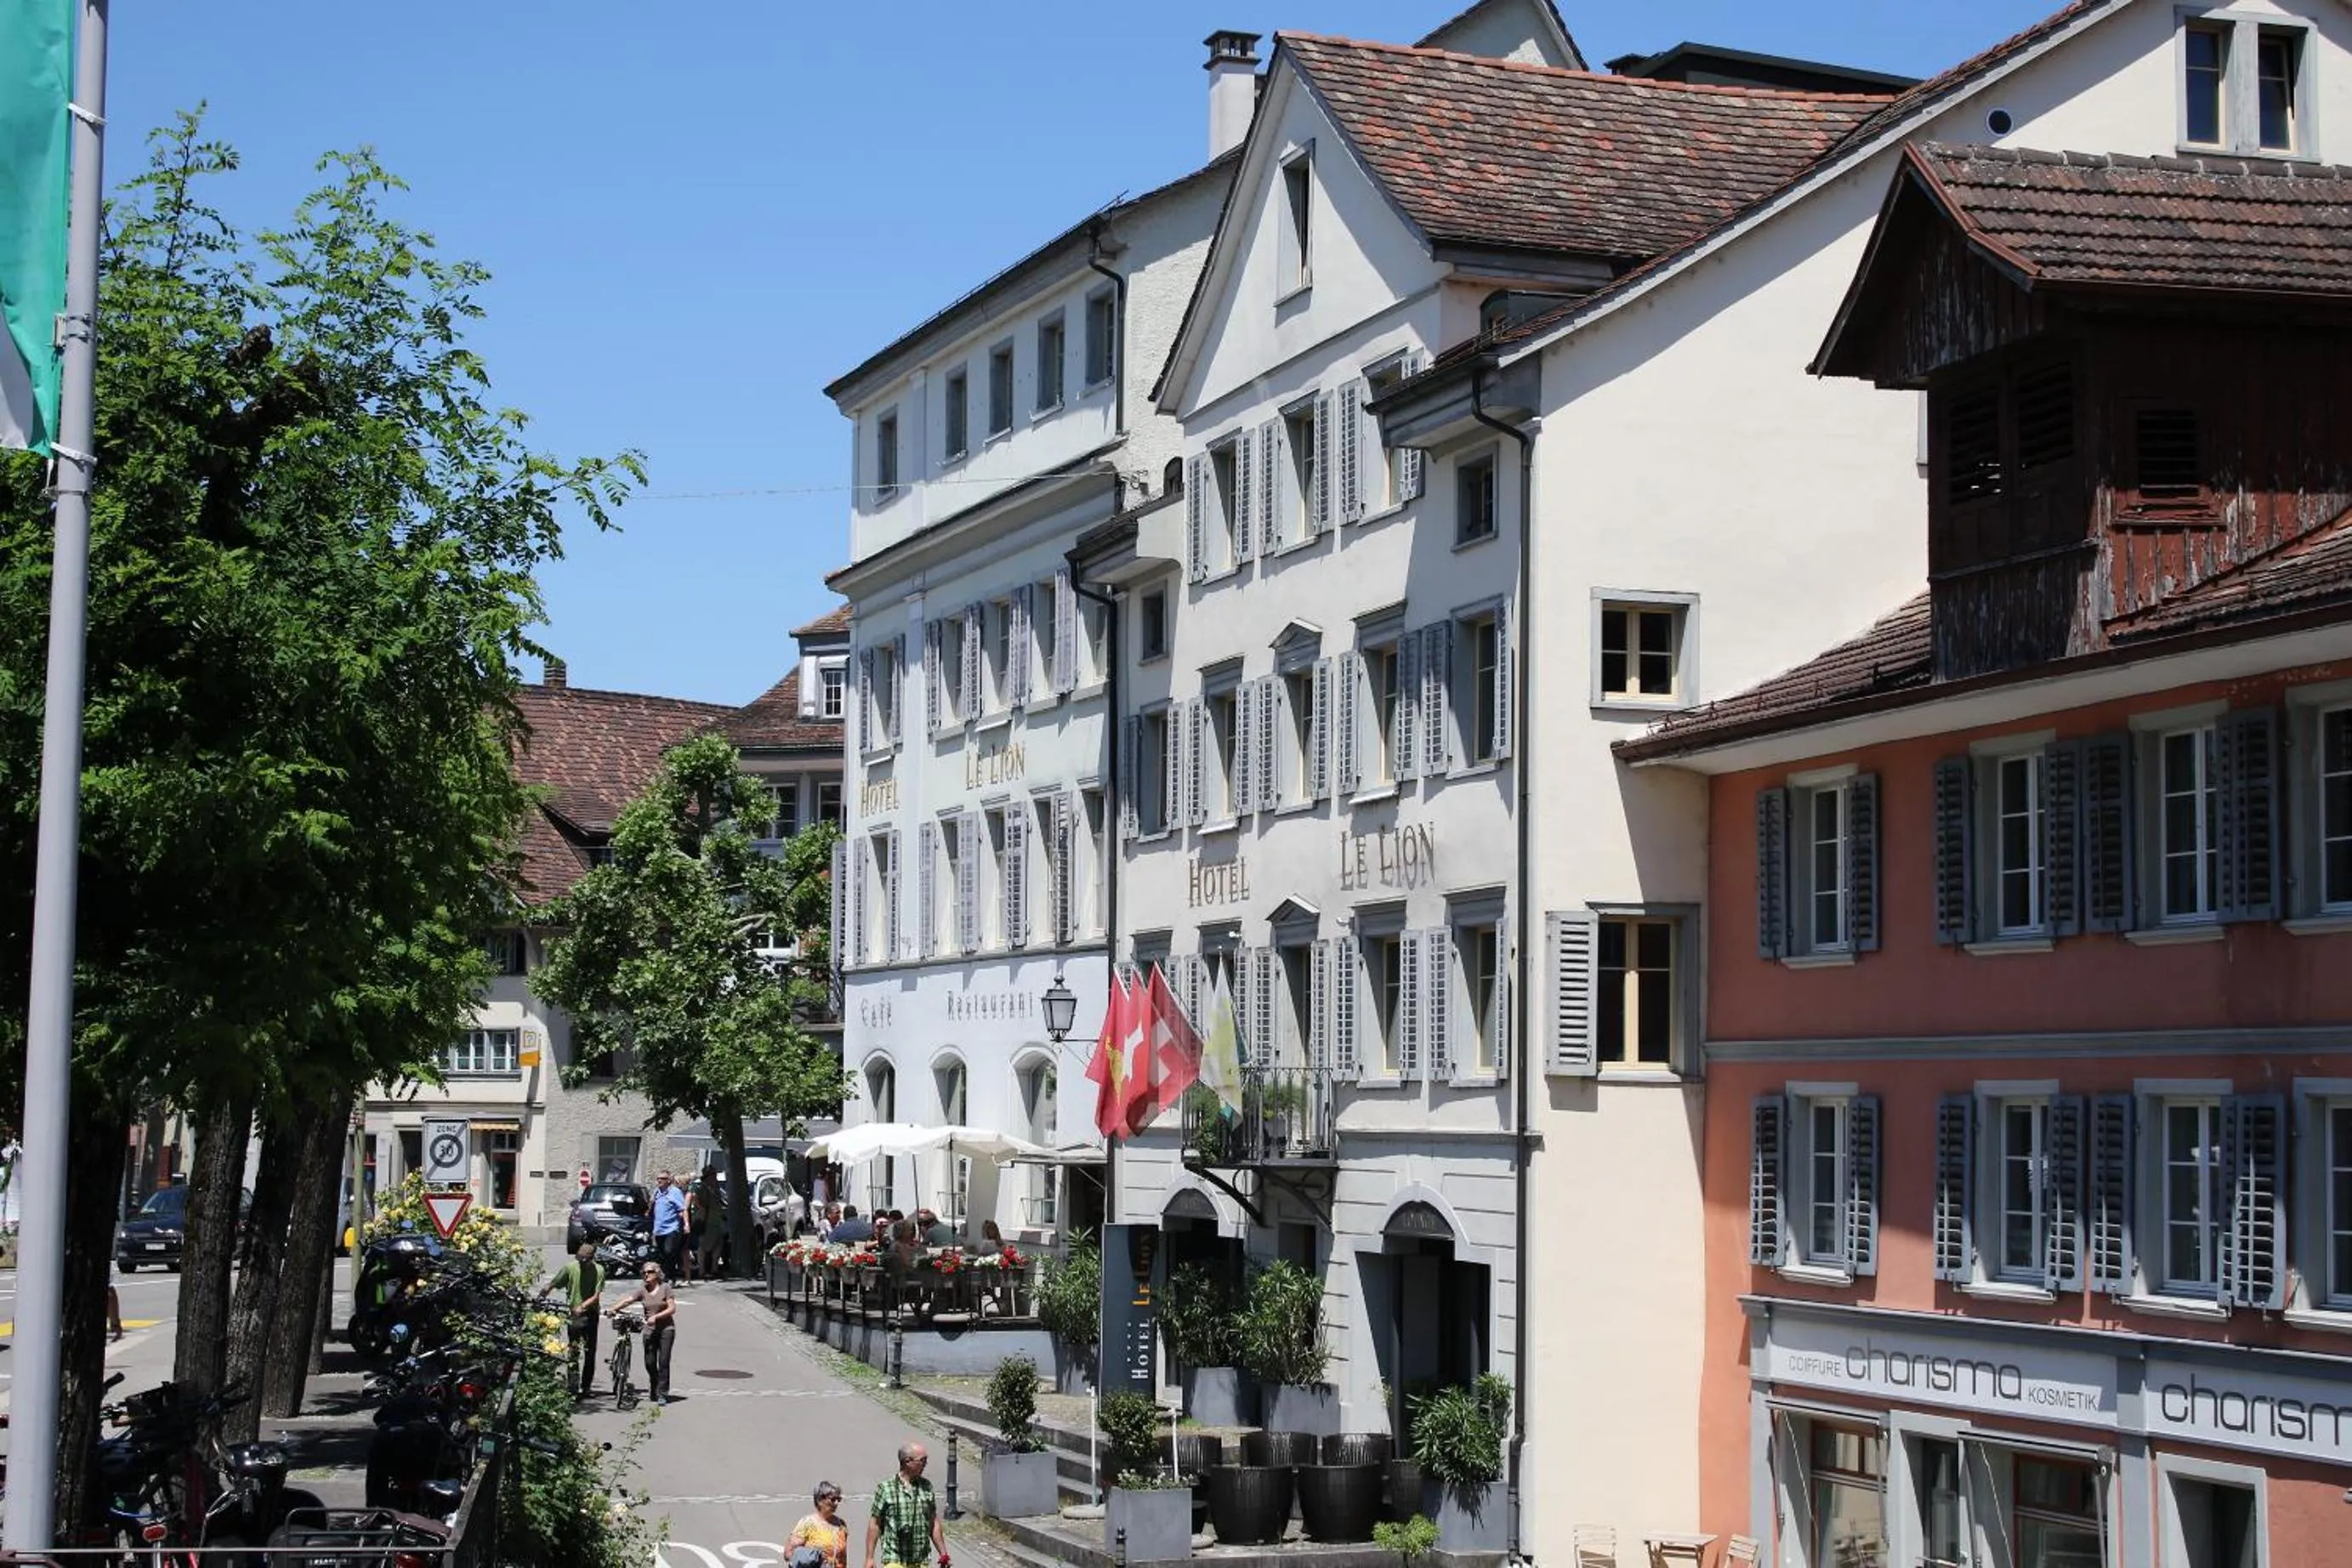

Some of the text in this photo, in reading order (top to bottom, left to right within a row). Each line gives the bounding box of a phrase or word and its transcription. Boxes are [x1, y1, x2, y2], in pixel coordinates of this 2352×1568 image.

[966, 740, 1026, 791] LE LION
[860, 777, 899, 819] HOTEL
[1188, 855, 1250, 908] HOTEL
[1338, 821, 1436, 891] LE LION
[438, 1144, 454, 1158] 30
[1133, 1282, 1150, 1305] LE
[1131, 1319, 1150, 1379] HOTEL
[1788, 1336, 2097, 1411] COIFFURE charisma KOSMETIK
